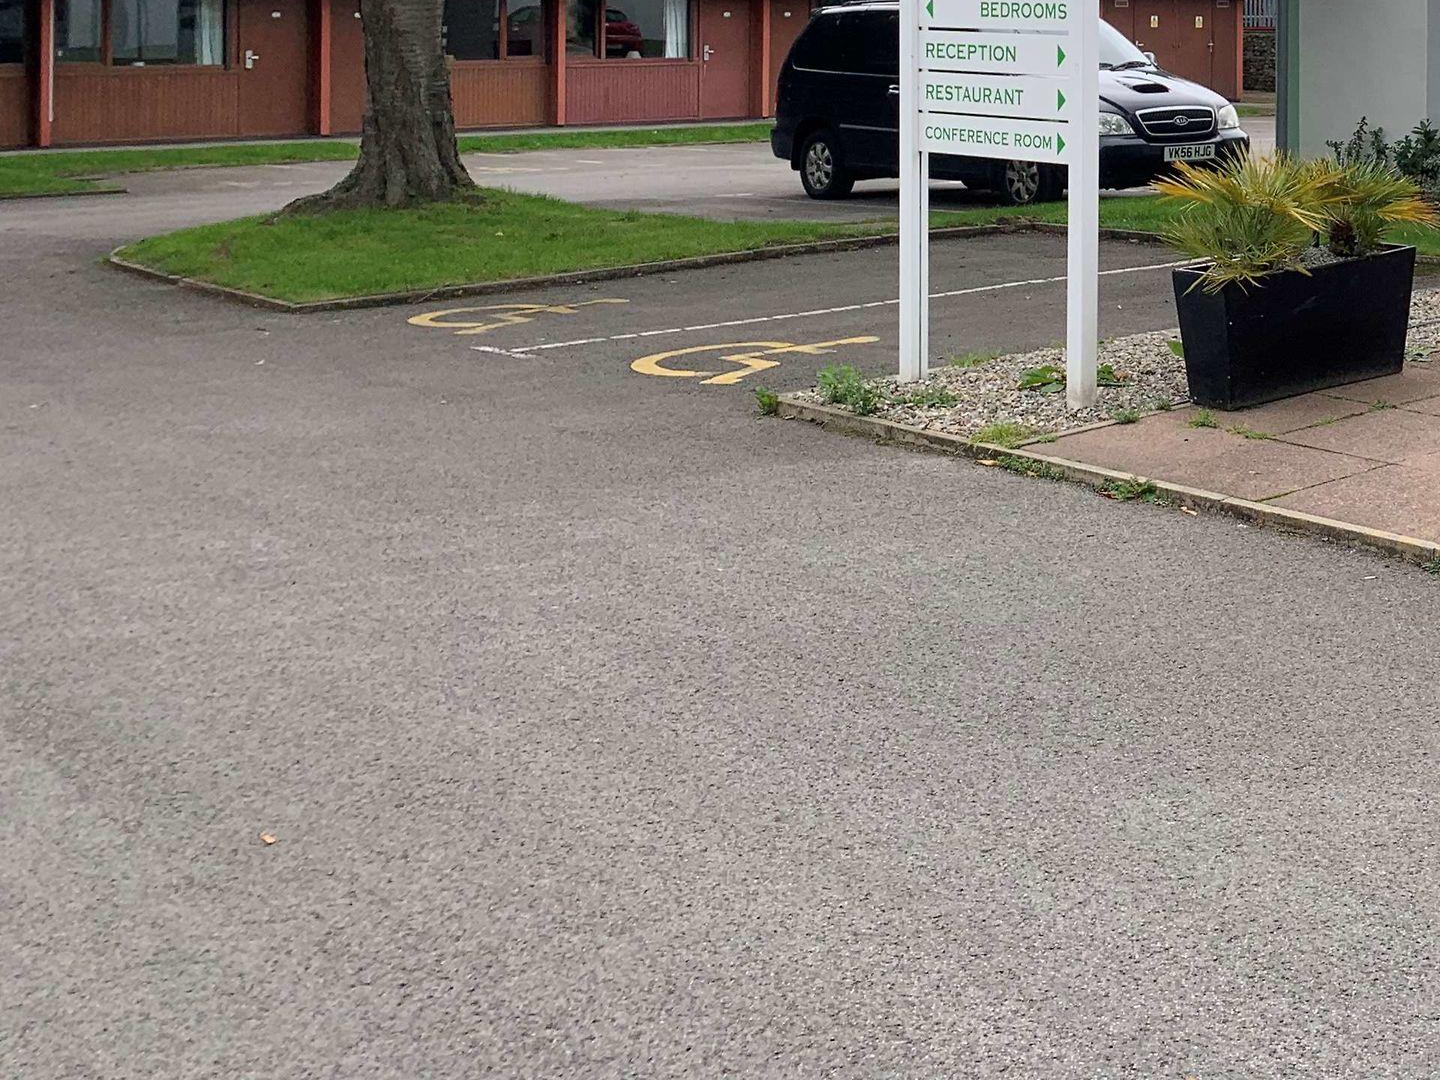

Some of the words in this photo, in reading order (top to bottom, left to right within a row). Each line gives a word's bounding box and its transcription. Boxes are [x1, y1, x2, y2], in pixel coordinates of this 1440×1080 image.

[980, 1, 1067, 20] BEDROOMS
[925, 42, 1017, 63] RECEPTION
[925, 84, 1024, 106] RESTAURANT
[925, 126, 1009, 146] CONFERENCE
[1014, 133, 1052, 150] ROOM
[1194, 145, 1212, 157] HJG
